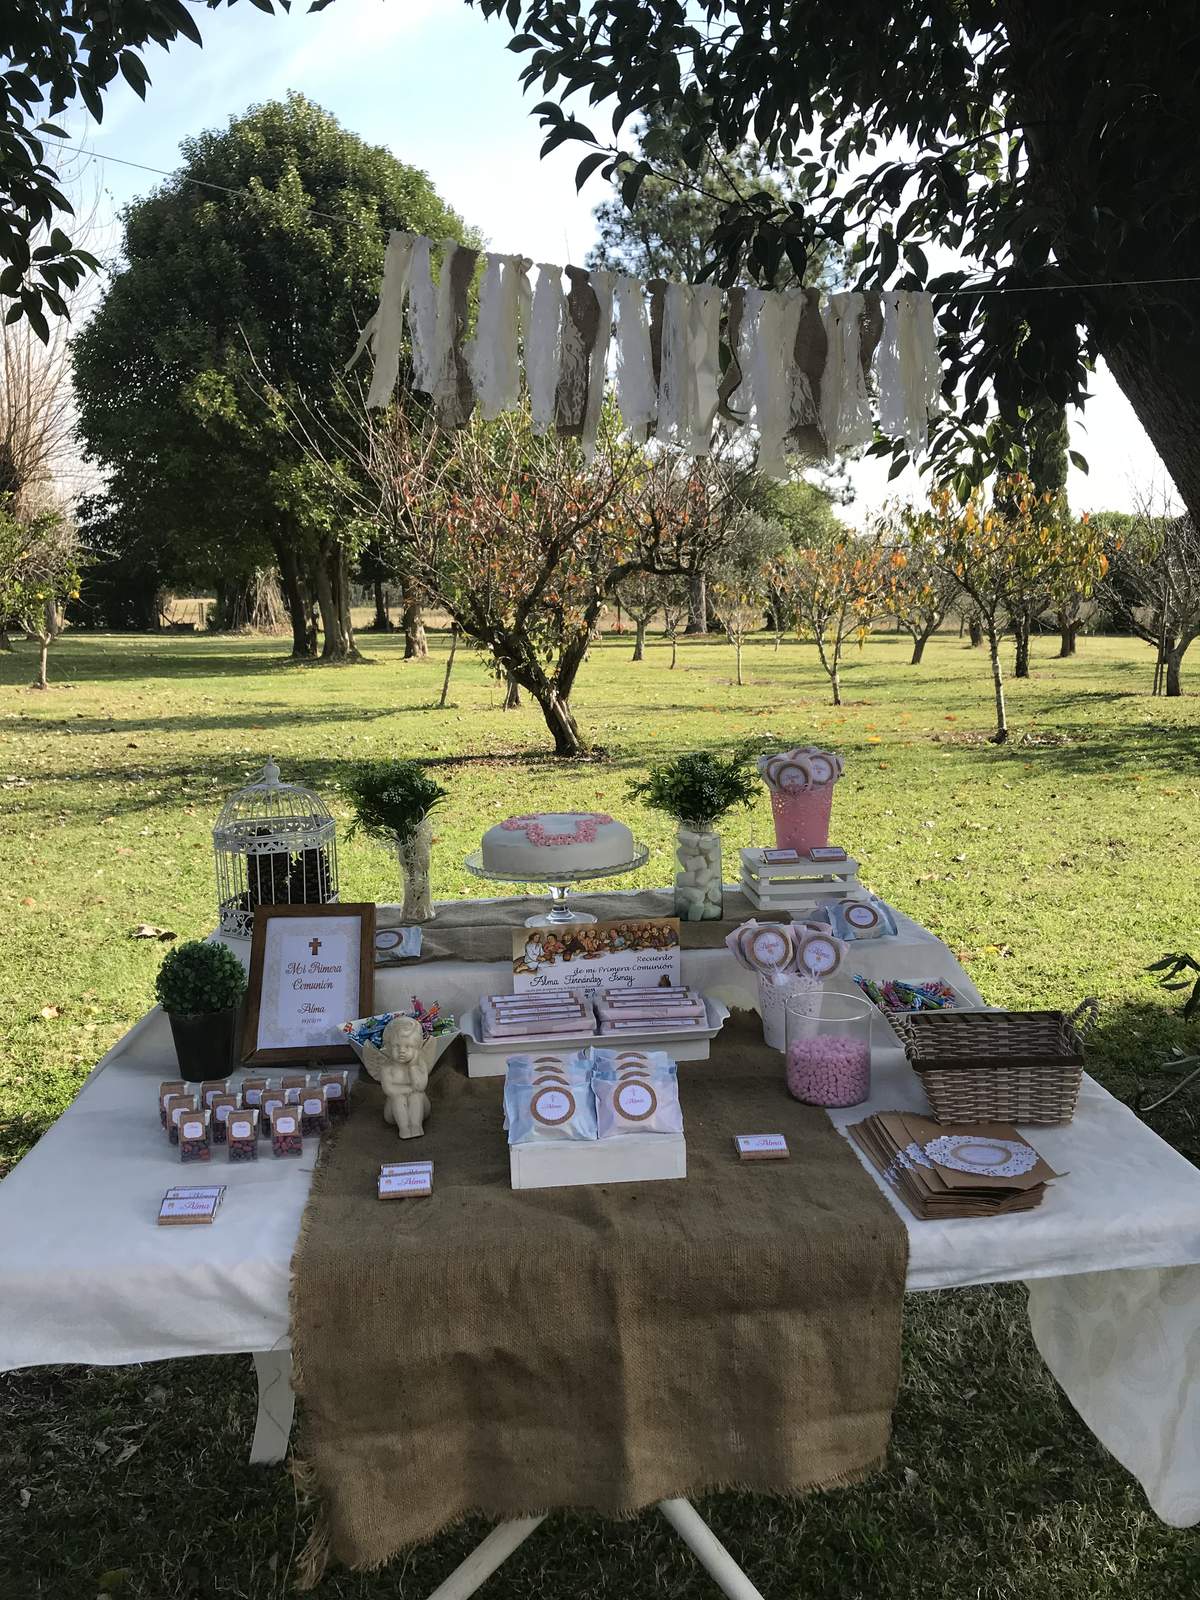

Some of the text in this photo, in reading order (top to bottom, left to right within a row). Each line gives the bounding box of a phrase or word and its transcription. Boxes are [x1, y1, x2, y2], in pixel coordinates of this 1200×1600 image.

[636, 953, 673, 963] Recuerdo
[286, 960, 343, 975] Mi Primera
[573, 967, 585, 976] de
[585, 966, 597, 974] mi
[599, 966, 630, 974] Primera
[291, 977, 334, 991] Comunión
[530, 975, 560, 986] Alma
[297, 1003, 325, 1014] Alma
